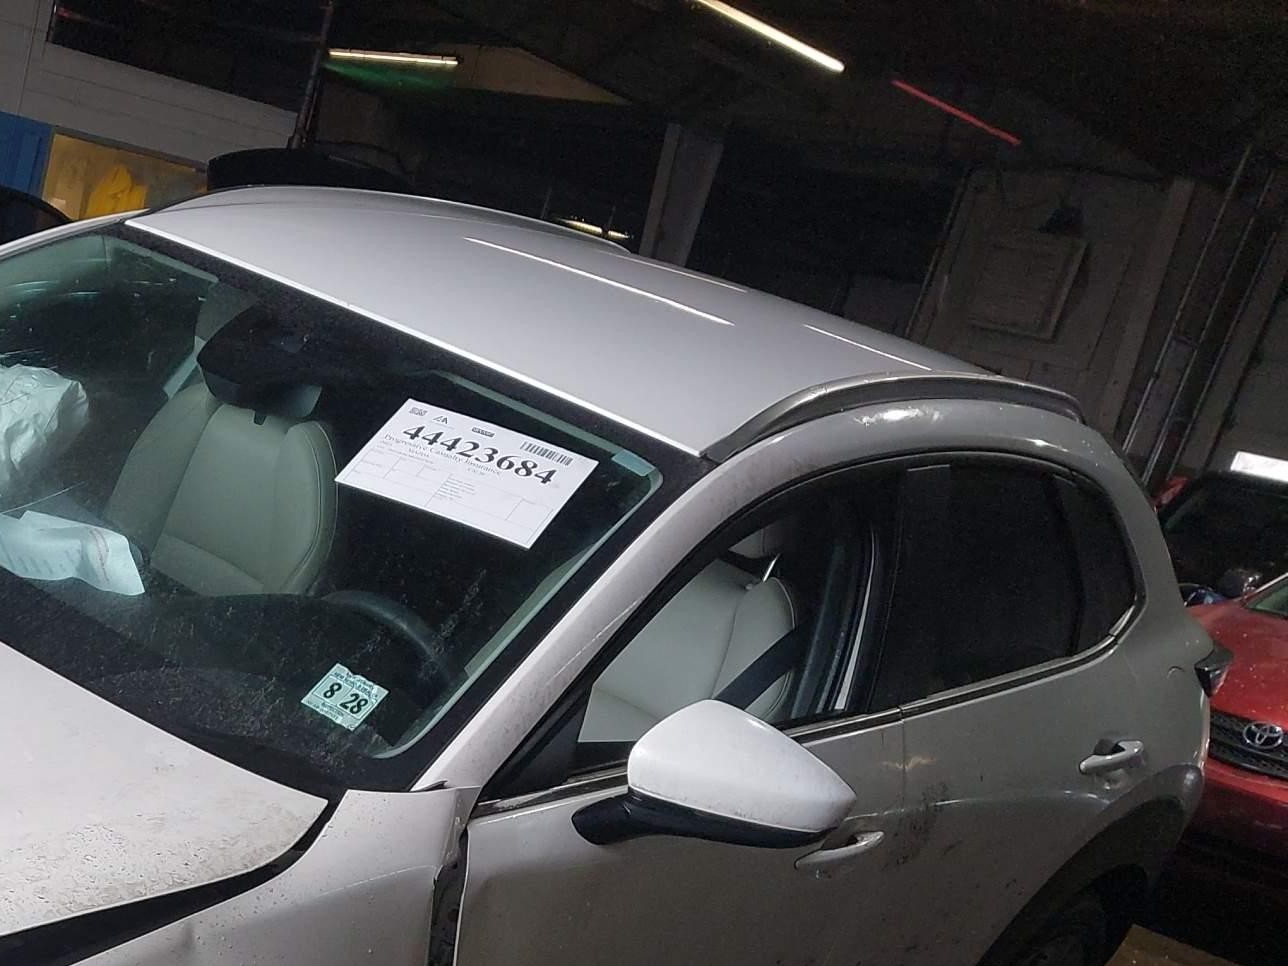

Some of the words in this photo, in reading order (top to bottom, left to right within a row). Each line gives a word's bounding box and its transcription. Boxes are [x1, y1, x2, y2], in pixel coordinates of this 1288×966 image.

[403, 425, 557, 485] 44423684
[323, 683, 342, 699] 8
[338, 693, 369, 715] 28
